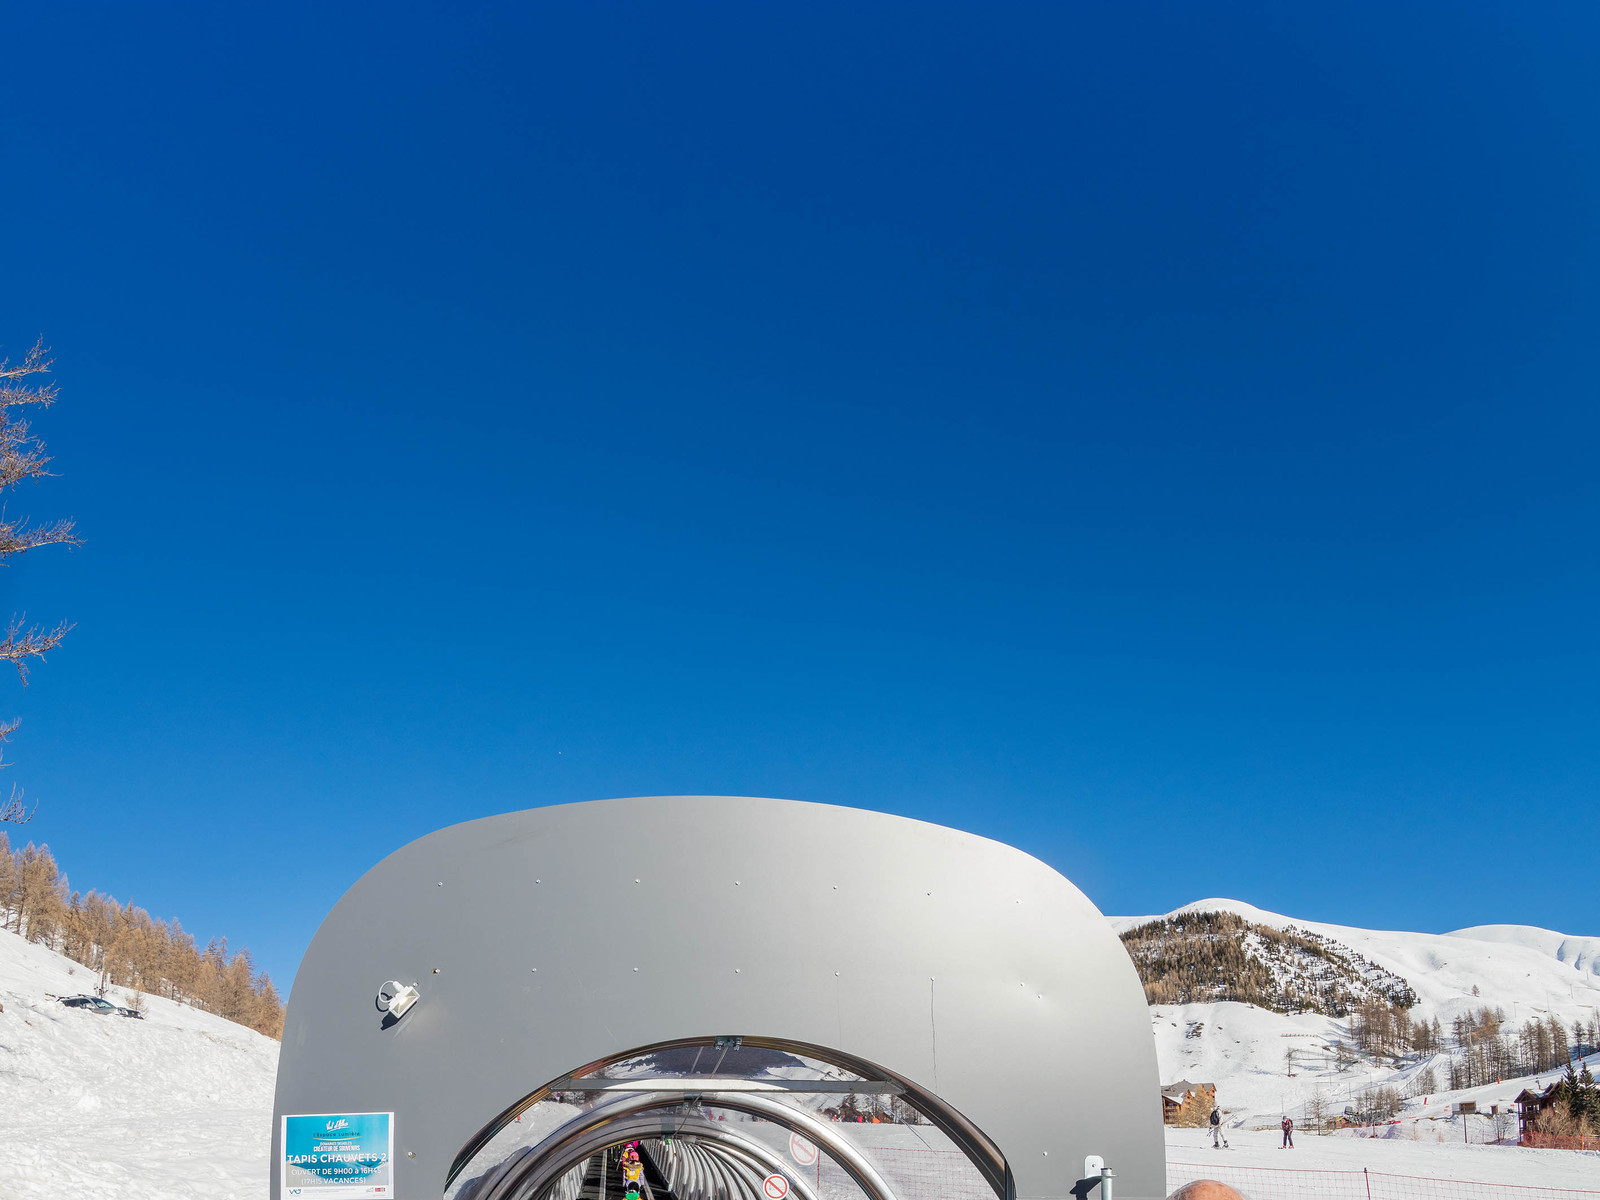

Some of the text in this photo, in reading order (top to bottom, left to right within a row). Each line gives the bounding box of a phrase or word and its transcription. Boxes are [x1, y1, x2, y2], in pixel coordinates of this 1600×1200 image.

[287, 1152, 387, 1164] TAPIS CHAUVETS 2
[291, 1168, 321, 1176] OUVERT
[322, 1167, 332, 1175] DE
[334, 1167, 353, 1175] 9H00
[354, 1166, 359, 1174] à
[323, 1176, 367, 1184] VACANCES)
